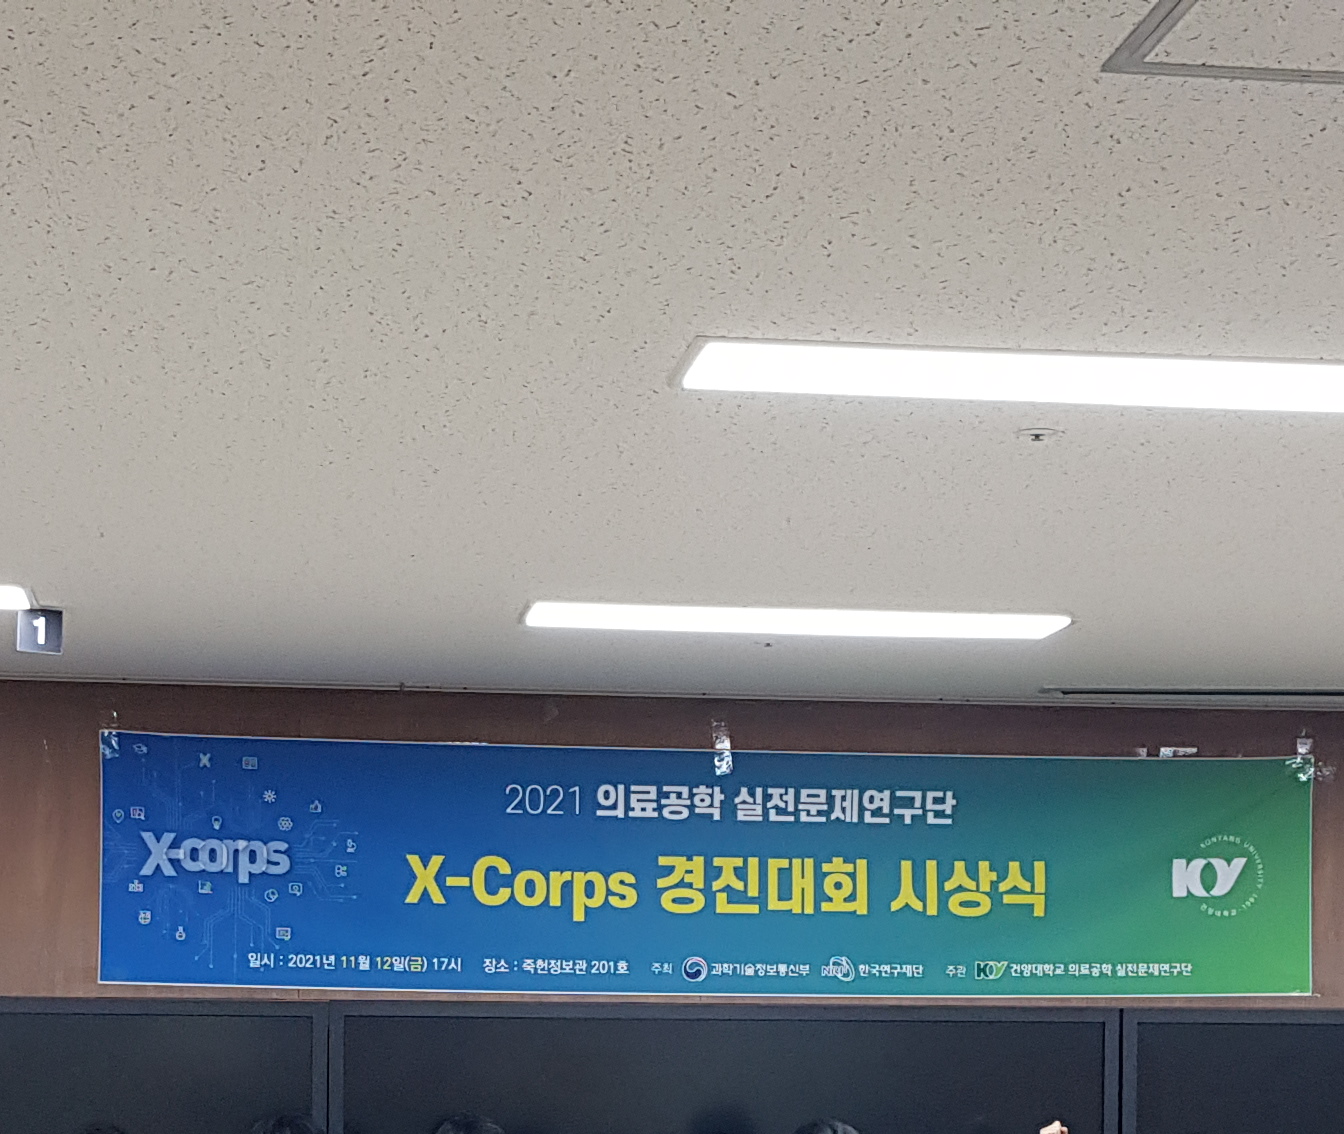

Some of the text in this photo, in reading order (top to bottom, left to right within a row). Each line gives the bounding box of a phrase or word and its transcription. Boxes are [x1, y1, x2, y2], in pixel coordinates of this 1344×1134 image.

[32, 616, 47, 646] 1
[505, 784, 957, 826] 2021 의료공학 실전문제연구단
[404, 853, 1047, 922] X-Corps 경진대회 시상식
[247, 952, 275, 969] 일시
[287, 953, 337, 970] 2021년
[341, 954, 371, 971] 11월
[376, 955, 428, 973] 12일(금)
[432, 956, 462, 973] 17시
[482, 957, 510, 975] 장소
[521, 958, 588, 976] 죽헌정보관
[590, 959, 631, 976] 201호
[711, 962, 811, 978] 과학기술정보통신부
[858, 962, 924, 979] 한국연구재단
[945, 963, 968, 979] 주관
[1010, 962, 1066, 978] 건양대학교
[1067, 962, 1113, 979] 의료공학
[1115, 962, 1194, 979] 실전문제연구단
